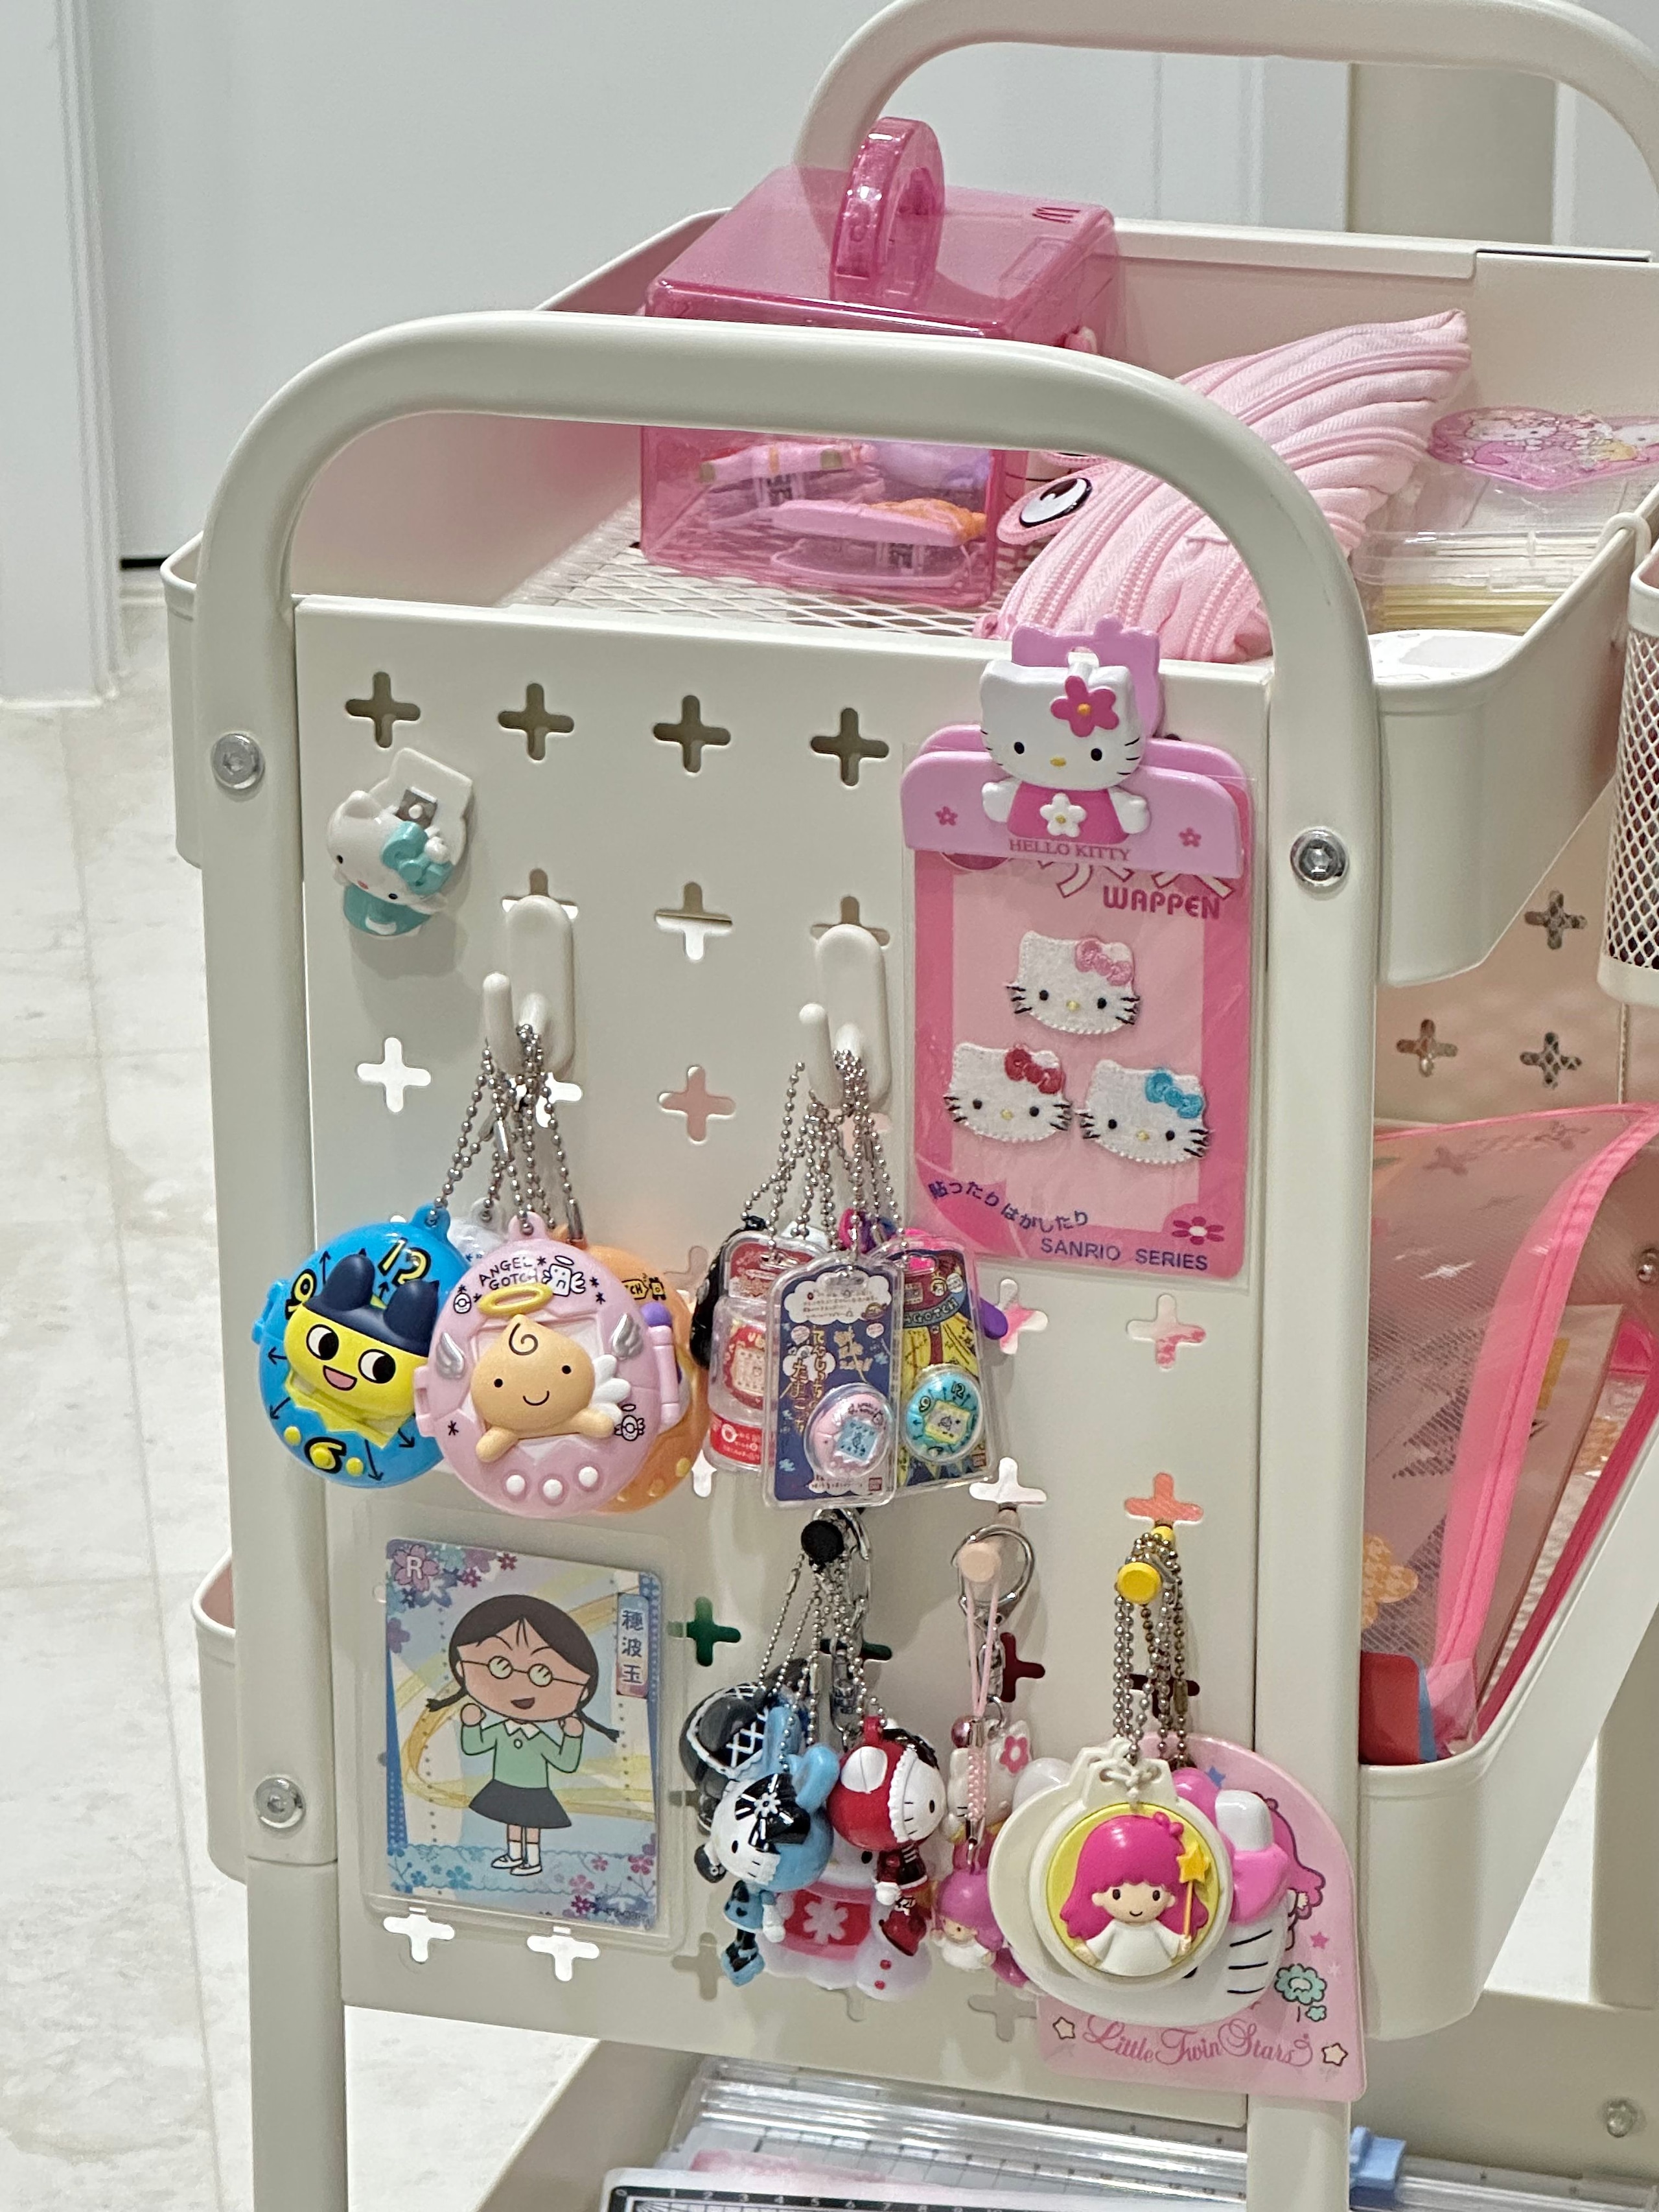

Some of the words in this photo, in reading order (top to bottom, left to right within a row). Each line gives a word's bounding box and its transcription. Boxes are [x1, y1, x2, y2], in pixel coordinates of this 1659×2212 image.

[1009, 839, 1069, 856] HELLO
[1075, 844, 1130, 861] KITTY
[1102, 885, 1220, 919] WAPPEN
[1041, 1237, 1122, 1261] SANRIO
[1135, 1248, 1209, 1271] SERIES
[478, 1256, 533, 1287] ANGEL
[488, 1268, 538, 1292] GOTCH
[951, 1381, 966, 1399] 12
[918, 1396, 932, 1413] 9
[406, 1555, 424, 1580] R
[1083, 2014, 1154, 2062] Little
[1155, 2027, 1222, 2066] Twin
[1218, 2018, 1314, 2067] Stars
